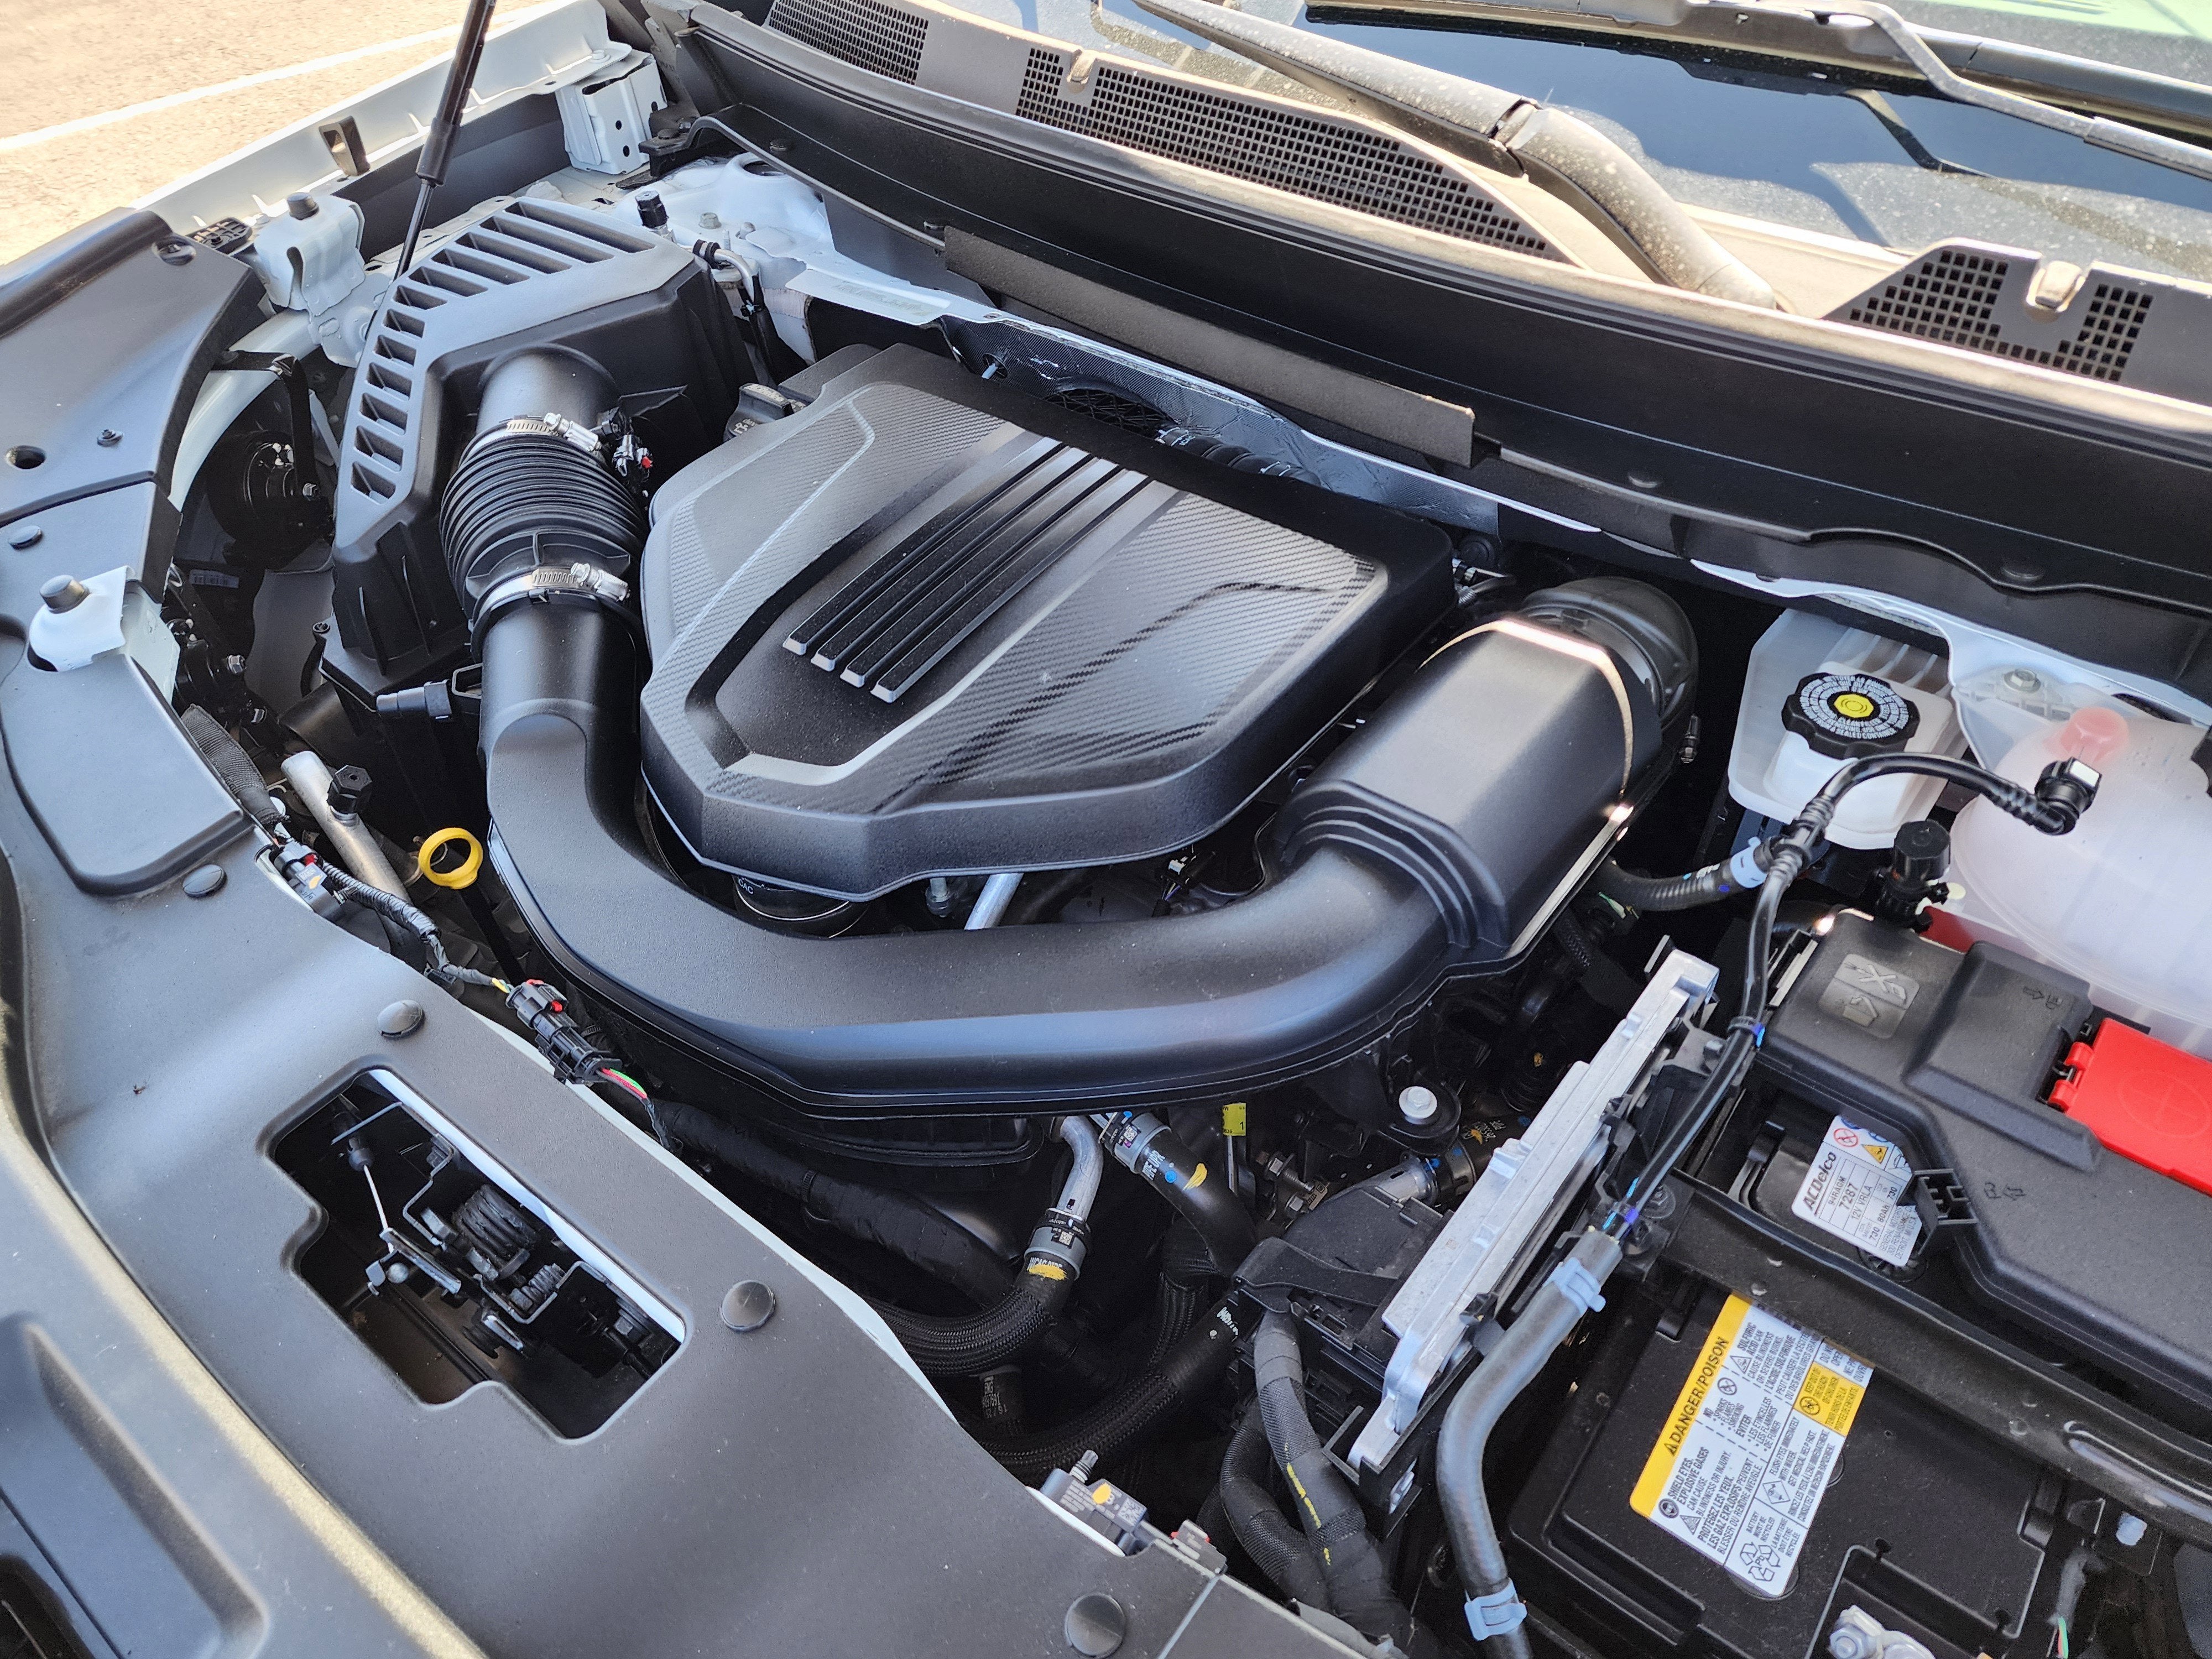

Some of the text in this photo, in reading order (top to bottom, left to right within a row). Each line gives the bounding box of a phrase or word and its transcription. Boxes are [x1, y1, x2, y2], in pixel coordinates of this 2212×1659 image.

[1800, 1149, 1838, 1211] ACDelco
[1838, 1182, 1859, 1211] 7287
[1856, 1183, 1873, 1207] VRLA
[1886, 1186, 1898, 1200] 730
[1851, 1206, 1863, 1221] 12V
[1868, 1225, 1880, 1241] 730
[1736, 1321, 1757, 1352] SULFURIC
[1745, 1328, 1765, 1357] ACID CAN
[1747, 1331, 1775, 1379] CAUSE BLINDNESS
[1773, 1334, 1796, 1369] SULFURIQUE
[1759, 1353, 1776, 1376] SEVERE
[1781, 1358, 1798, 1381] CAUSER
[1668, 1334, 1730, 1445] DANGER/POISON
[1775, 1379, 1788, 1396] PEUT
[1784, 1389, 1795, 1401] OU
[1788, 1379, 1800, 1392] DES
[1702, 1406, 1714, 1418] NO
[1713, 1397, 1729, 1420] SPARKS
[1720, 1401, 1736, 1424] FLAMES
[1727, 1402, 1745, 1428] SMOKING
[1746, 1426, 1759, 1440] LES
[1755, 1405, 1778, 1444] LES FLAMMES
[1763, 1420, 1782, 1449] DE FUMER
[1768, 1416, 1801, 1476] FLUSH EYES IMMEDIATELY
[1799, 1441, 1812, 1457] HELP
[1676, 1446, 1710, 1505] EXPLOSIVE GASES
[1790, 1454, 1807, 1477] MEDICAL
[1667, 1474, 1686, 1500] SHIELD
[1786, 1474, 1798, 1487] GET
[1686, 1475, 1708, 1511] CAN CAUSE
[1695, 1481, 1717, 1517] BLINDNESS
[1710, 1472, 1721, 1483] OR
[1707, 1457, 1755, 1549] LES GAZ EXPLOSIFS PEUVENT
[1712, 1493, 1726, 1509] LES
[1733, 1490, 1751, 1517] RENDRE
[1728, 1515, 1740, 1527] OU
[1745, 1510, 1760, 1533] BATTERY
[1752, 1522, 1764, 1538] MUST
[1759, 1516, 1776, 1542] RECYCLED
[1770, 1516, 1788, 1549] LA BATTERIE
[1715, 1524, 1736, 1555] BLESSER
[1777, 1538, 1788, 1553] DOIT
[1754, 1553, 1765, 1567] Pb
